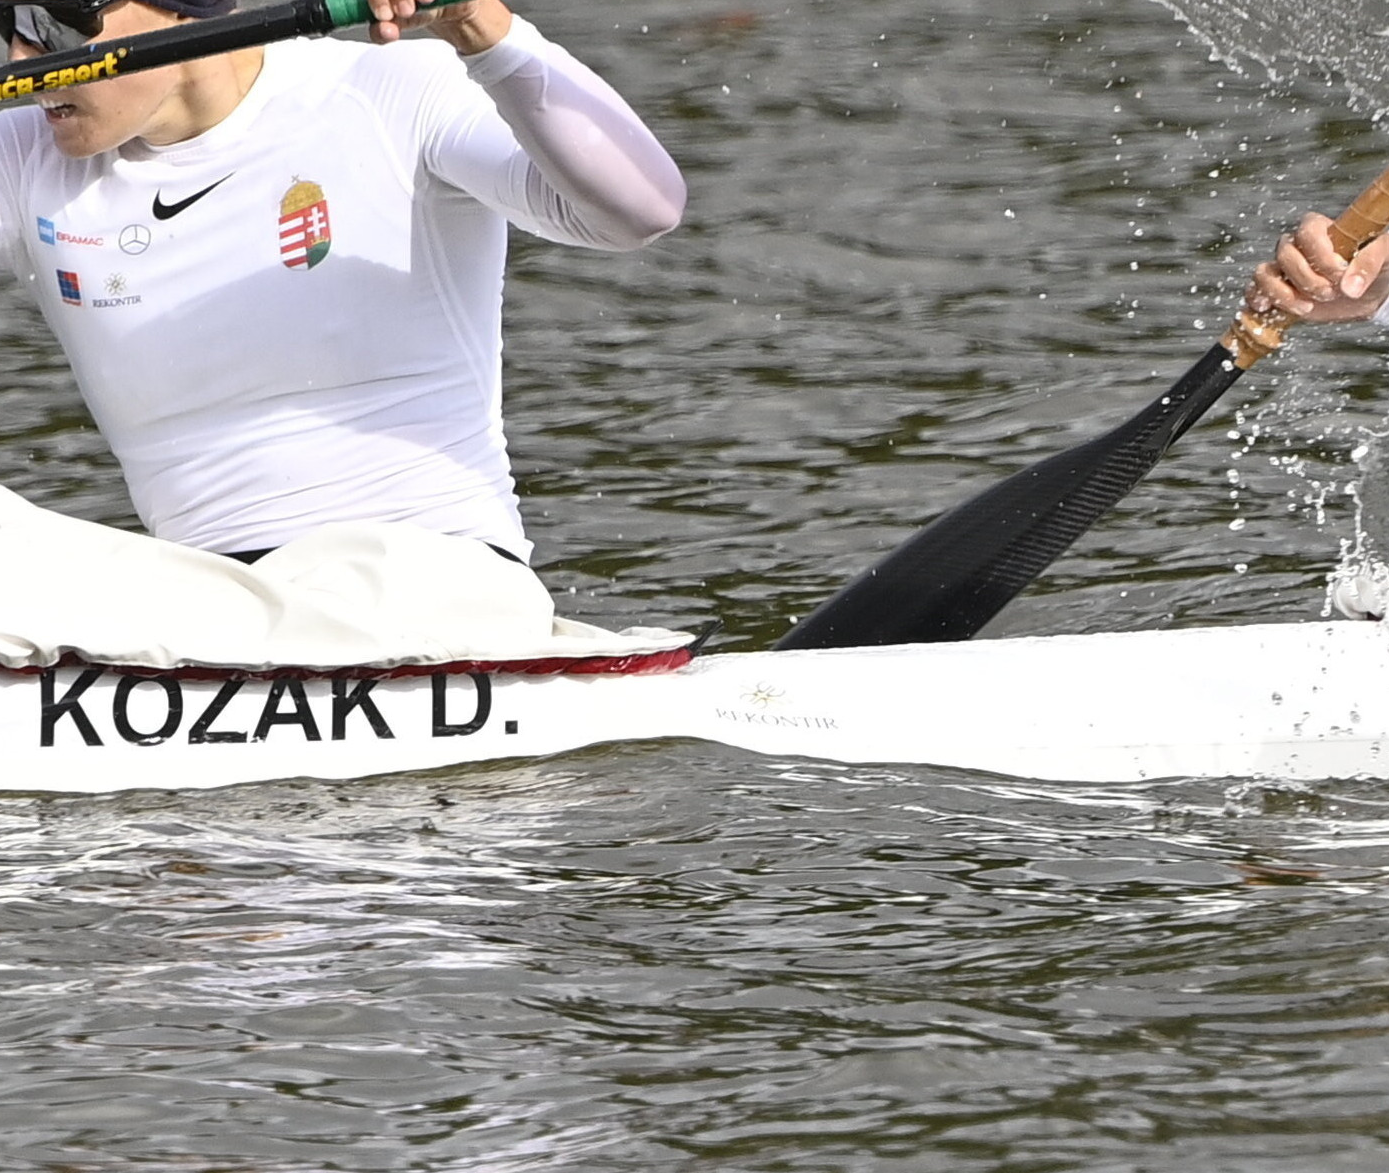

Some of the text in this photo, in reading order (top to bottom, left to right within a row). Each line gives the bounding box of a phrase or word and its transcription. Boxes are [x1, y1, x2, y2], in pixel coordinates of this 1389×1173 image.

[56, 231, 104, 246] BRAMAC
[92, 295, 142, 308] REKONTIR
[39, 668, 519, 748] KOZAK D.
